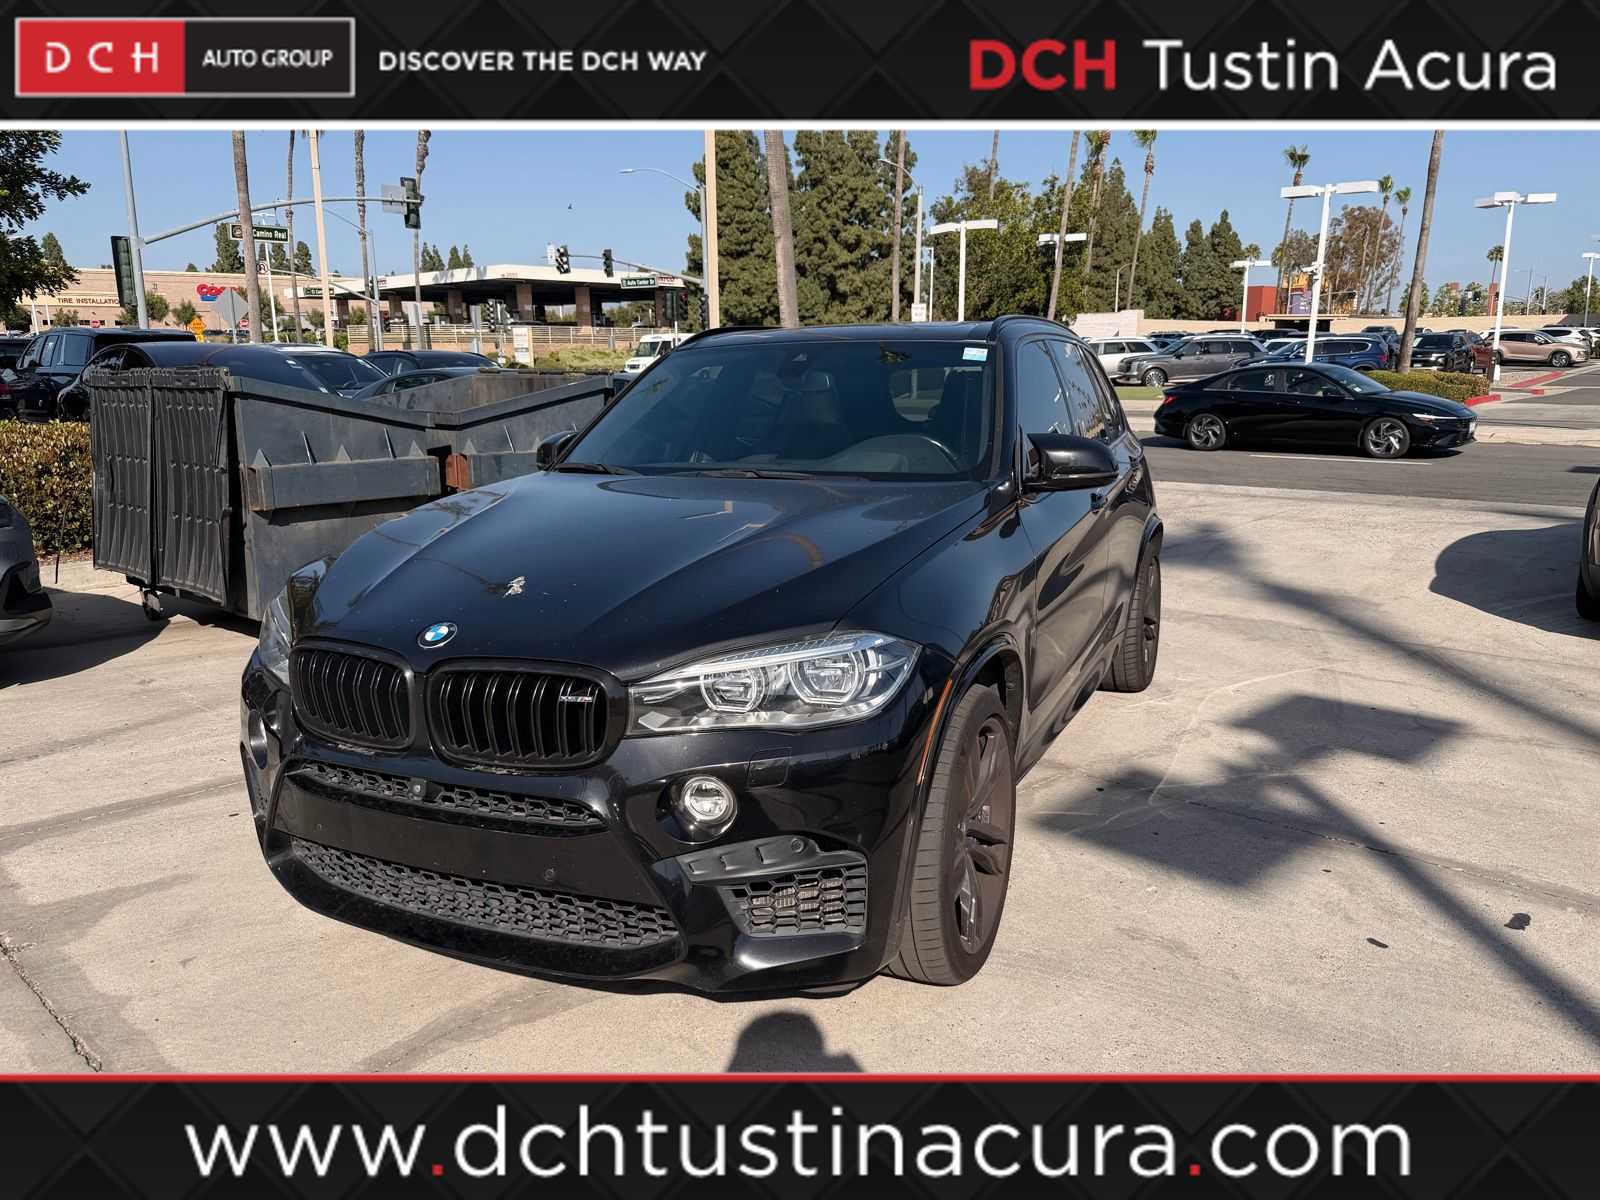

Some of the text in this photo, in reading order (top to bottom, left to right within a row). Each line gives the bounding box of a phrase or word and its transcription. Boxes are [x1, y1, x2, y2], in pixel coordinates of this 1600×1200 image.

[252, 229, 287, 239] Camino Real
[76, 297, 119, 305] INSTALLATIO
